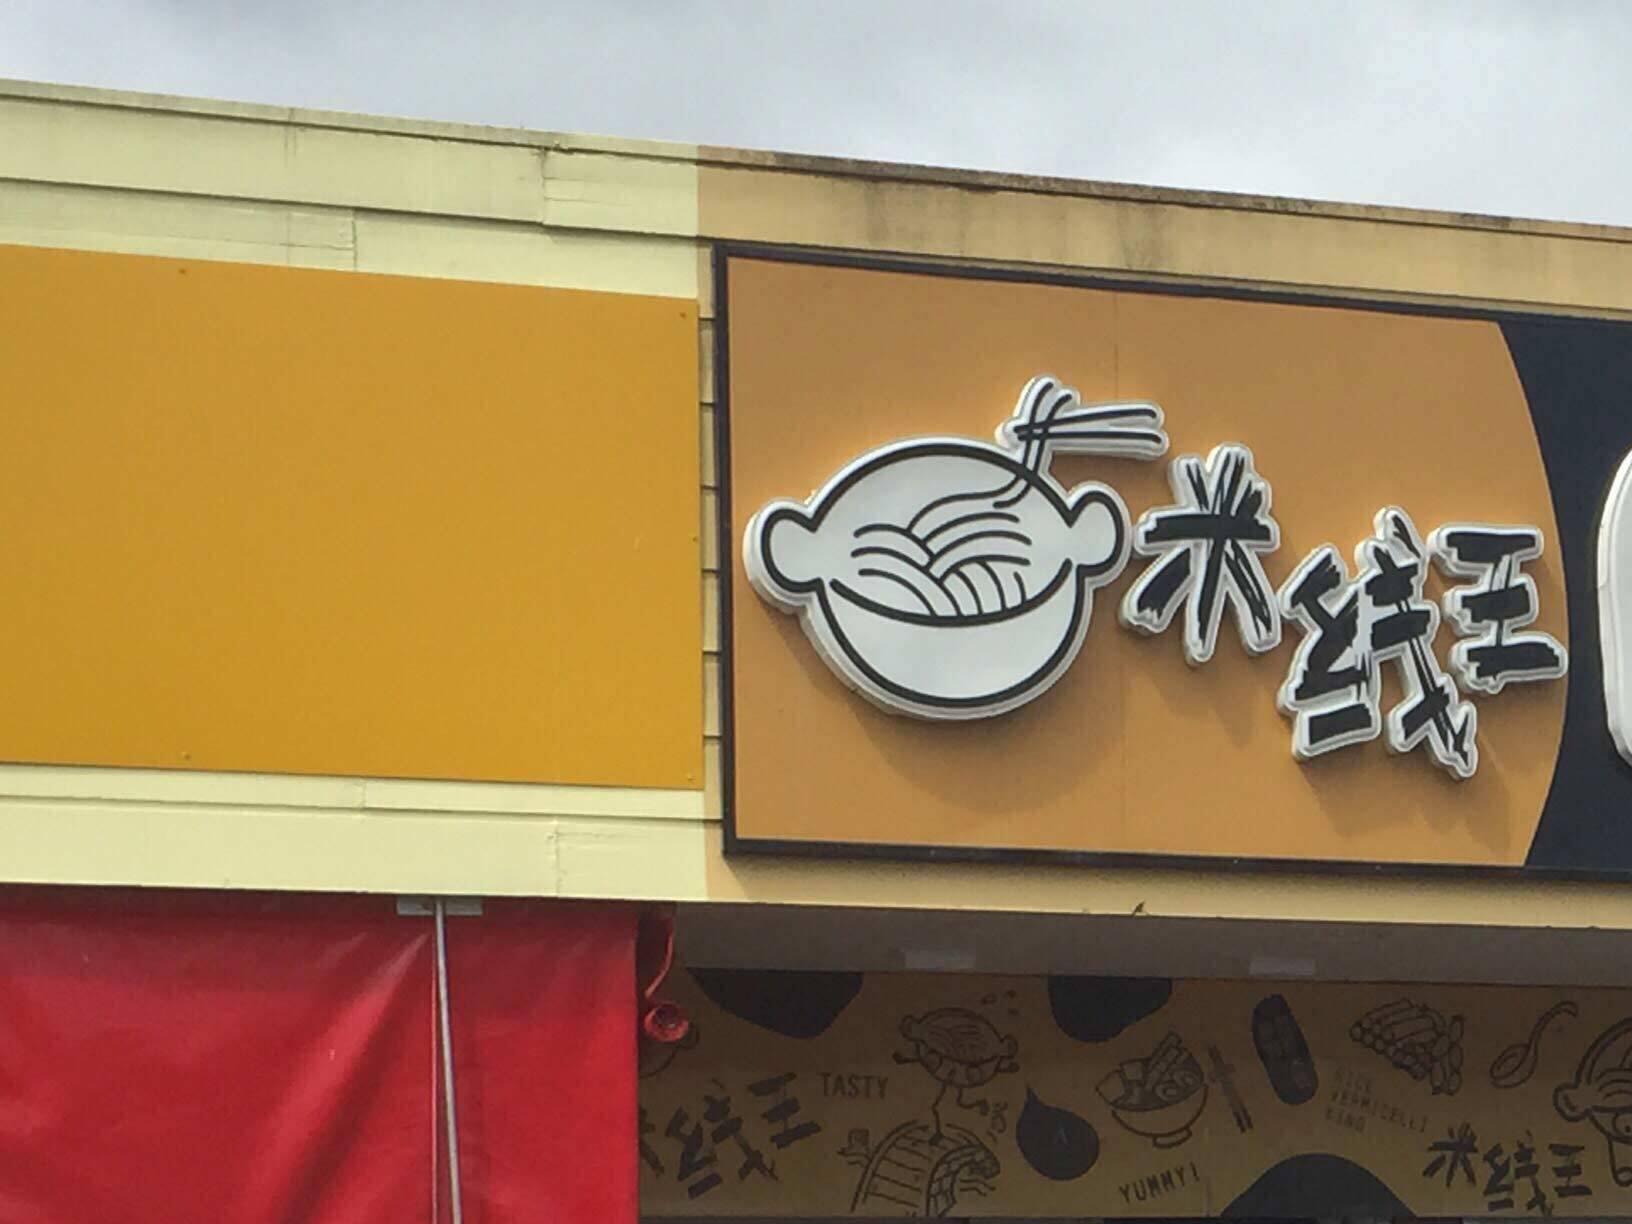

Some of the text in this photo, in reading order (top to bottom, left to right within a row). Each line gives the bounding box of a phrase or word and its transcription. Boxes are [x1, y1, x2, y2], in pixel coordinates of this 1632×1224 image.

[1120, 443, 1567, 778] 米线王
[818, 1072, 888, 1100] TASTY
[1118, 1168, 1202, 1204] YUMMY!
[1423, 1124, 1592, 1217] 米线王
